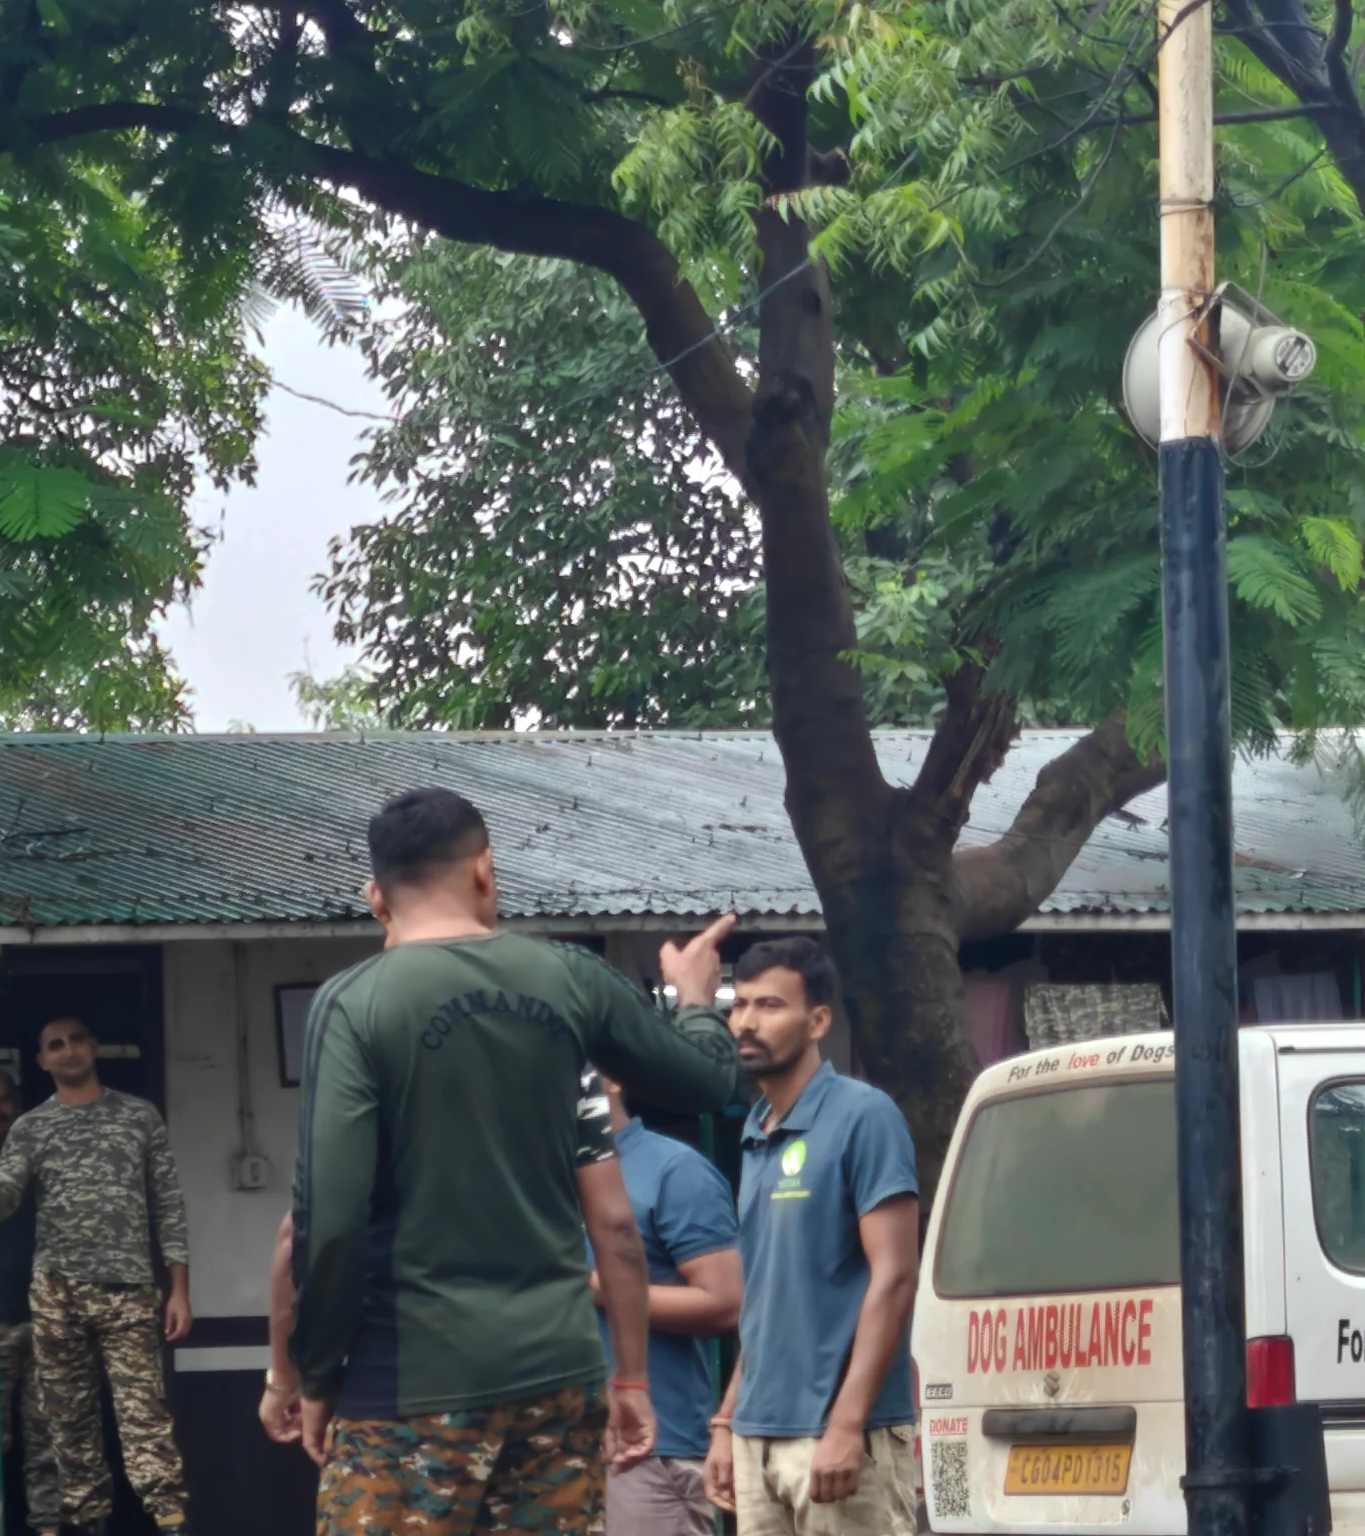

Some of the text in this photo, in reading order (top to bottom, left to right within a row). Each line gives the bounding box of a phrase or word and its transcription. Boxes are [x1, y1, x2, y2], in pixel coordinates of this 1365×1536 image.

[1007, 1065, 1032, 1083] For
[1035, 1057, 1060, 1075] the
[1065, 1052, 1101, 1070] love
[1106, 1045, 1127, 1064] of
[967, 1298, 1154, 1374] DOG AMBULANCE
[1337, 1318, 1365, 1364] Fo
[929, 1416, 968, 1434] DONATE
